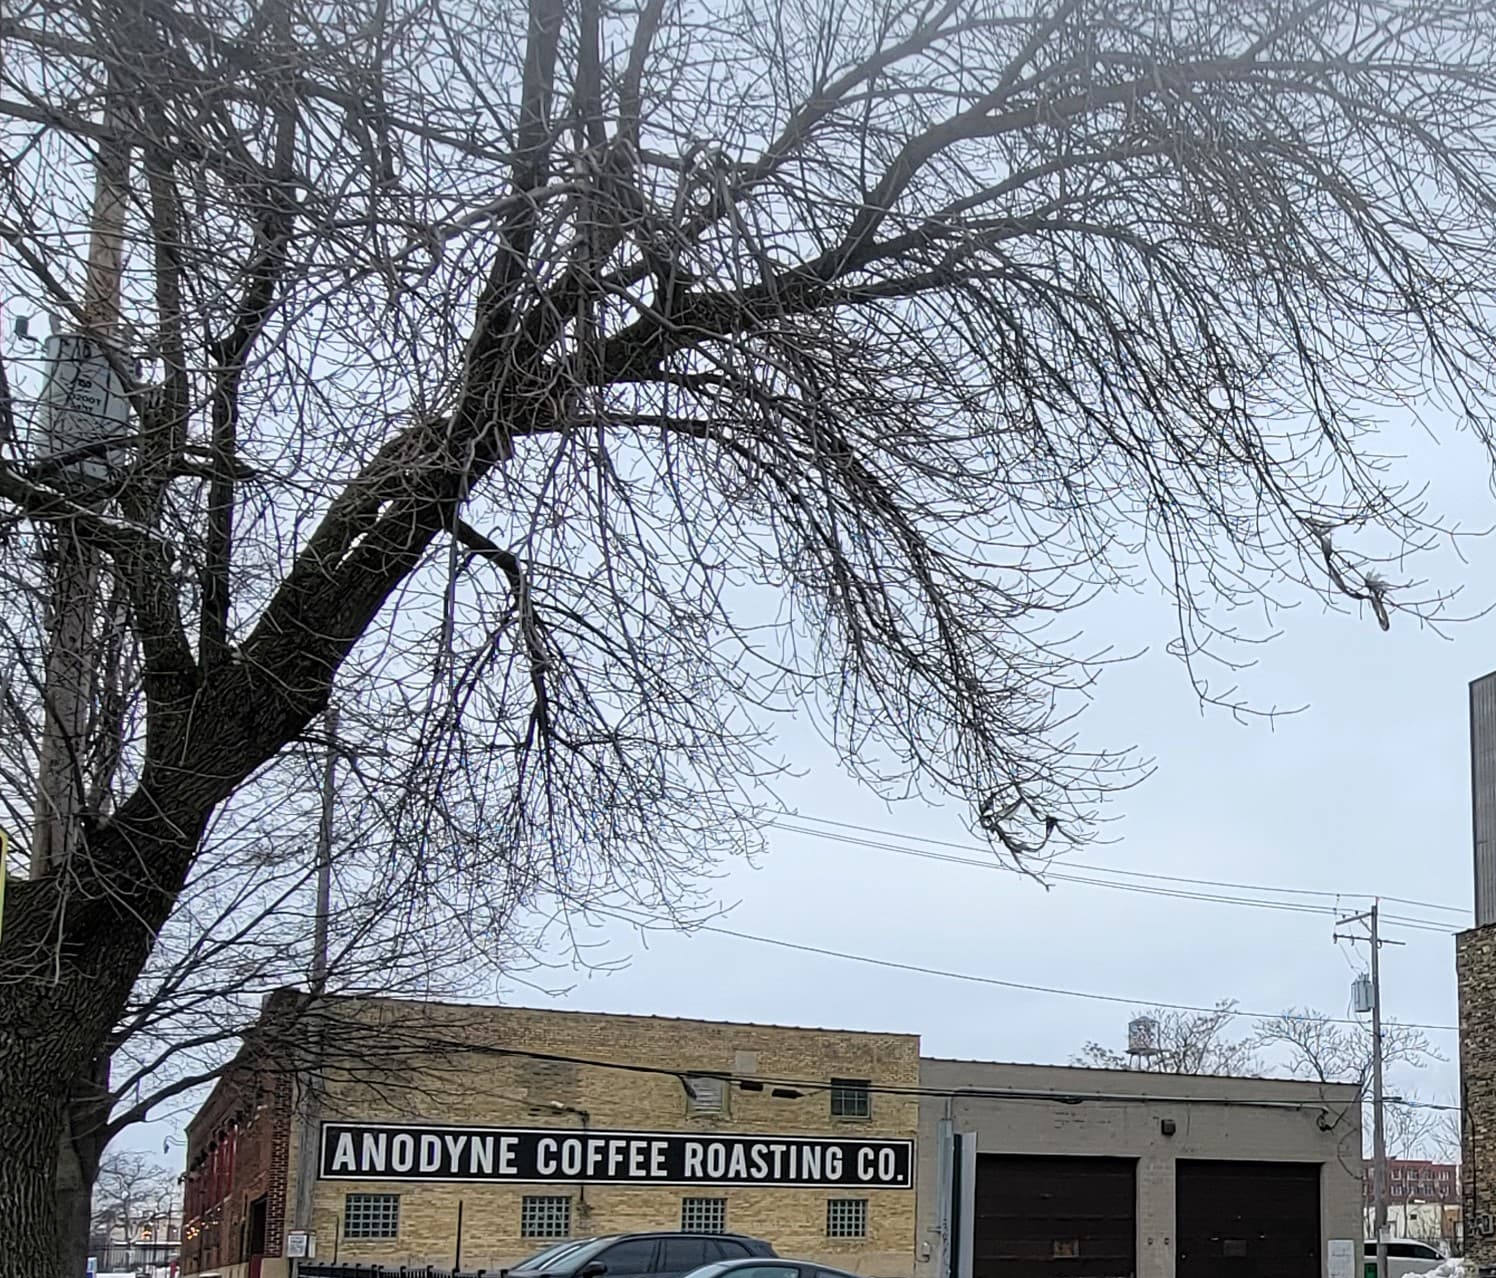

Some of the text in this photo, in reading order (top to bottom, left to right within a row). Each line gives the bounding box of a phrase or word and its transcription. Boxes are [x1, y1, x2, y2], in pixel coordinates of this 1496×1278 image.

[331, 1131, 904, 1182] ANODYNE COFFEE ROASTING CO.
